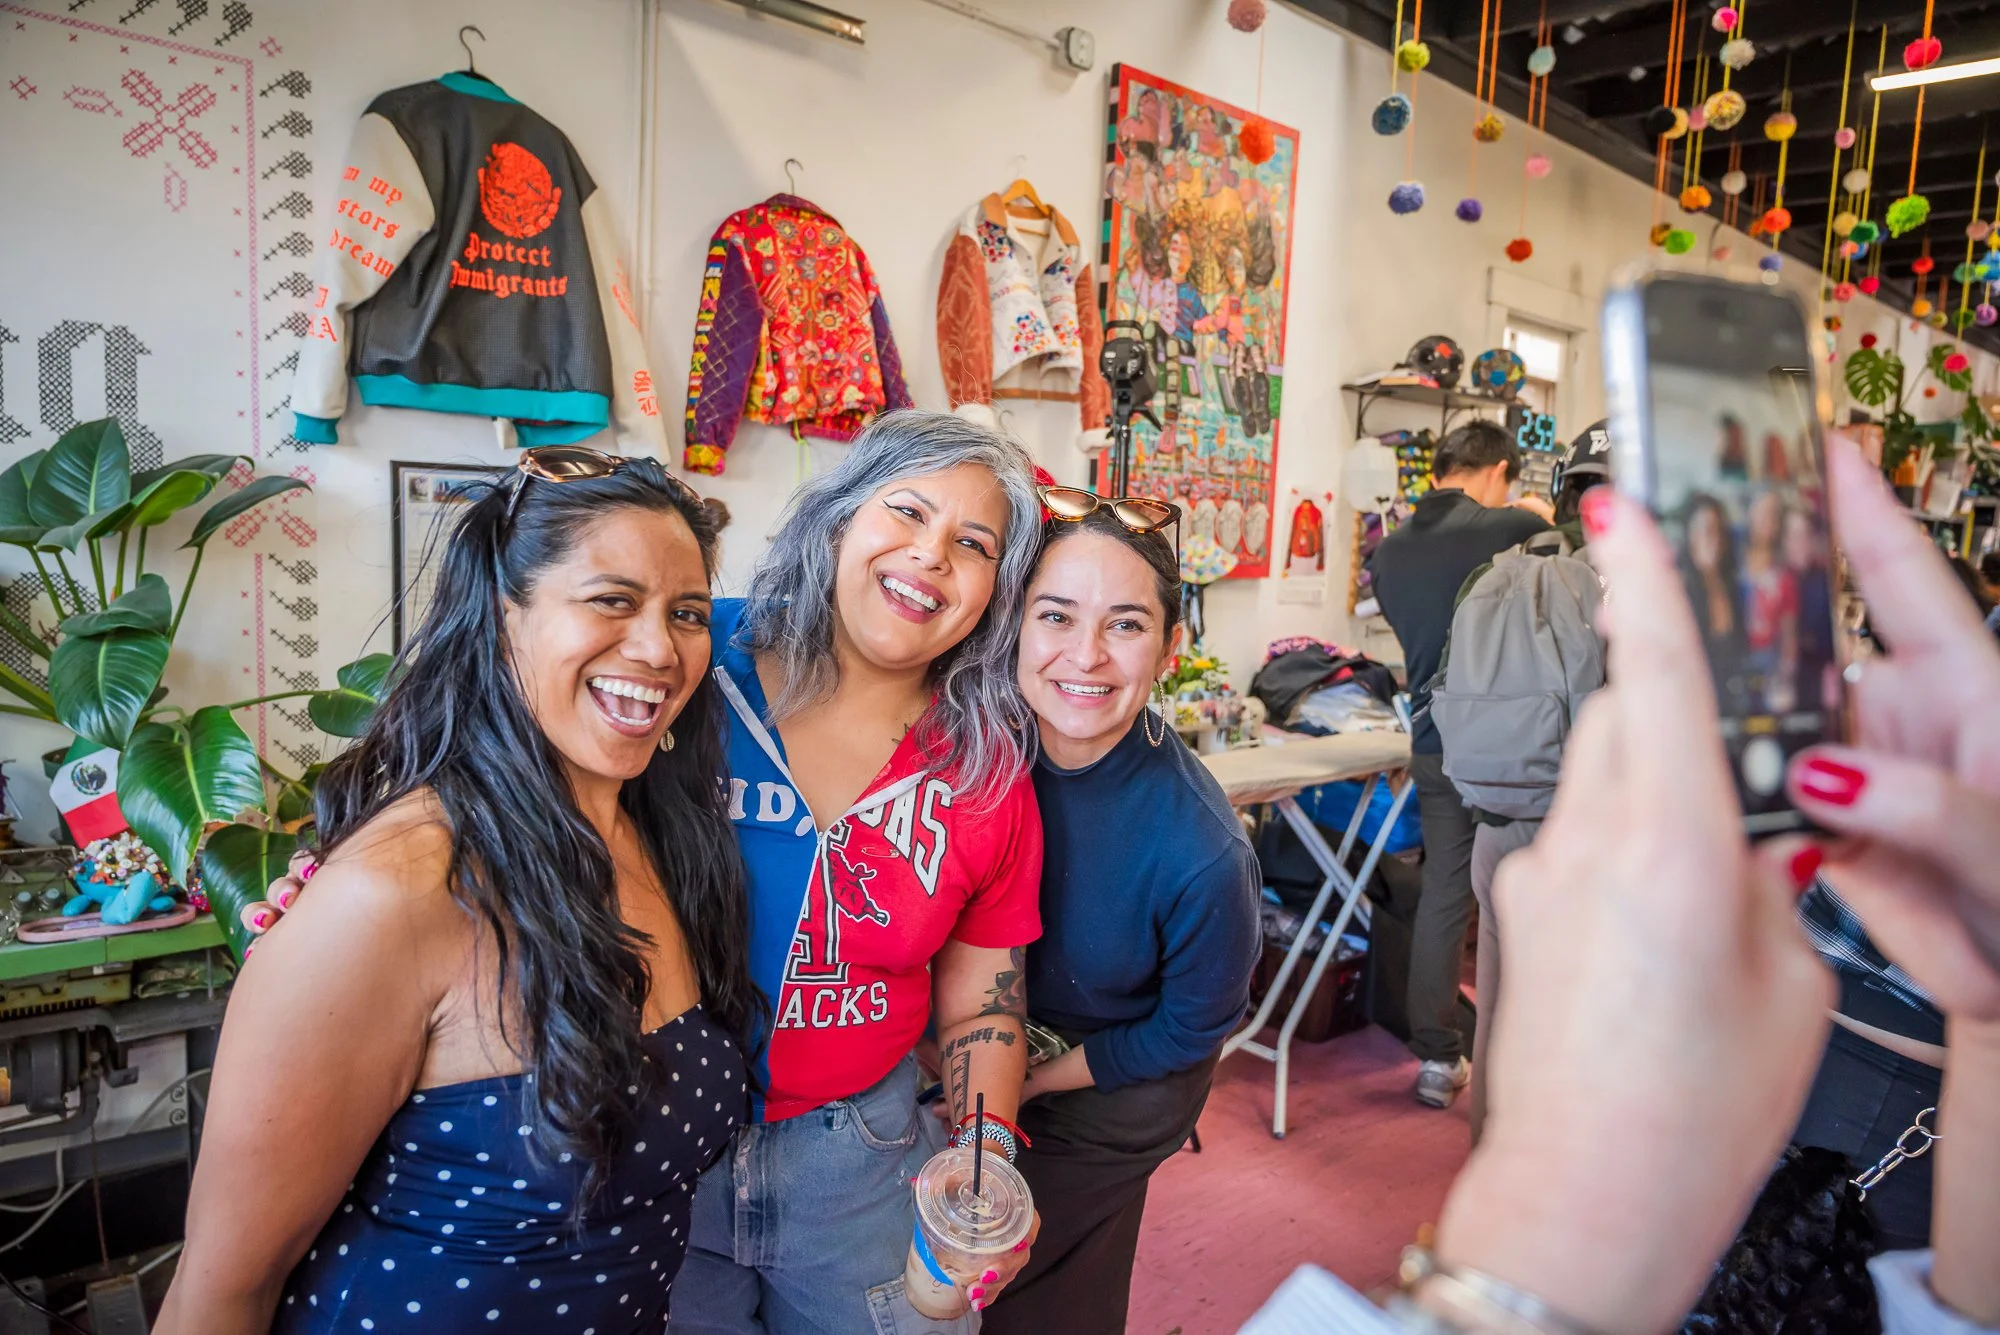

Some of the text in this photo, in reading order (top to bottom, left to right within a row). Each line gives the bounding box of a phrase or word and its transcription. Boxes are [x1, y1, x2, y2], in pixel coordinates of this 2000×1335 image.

[368, 176, 403, 207] my
[464, 232, 551, 267] Protect
[449, 260, 568, 298] Immigrants
[1517, 409, 1556, 452] 2:53
[777, 981, 888, 1029] ACKS
